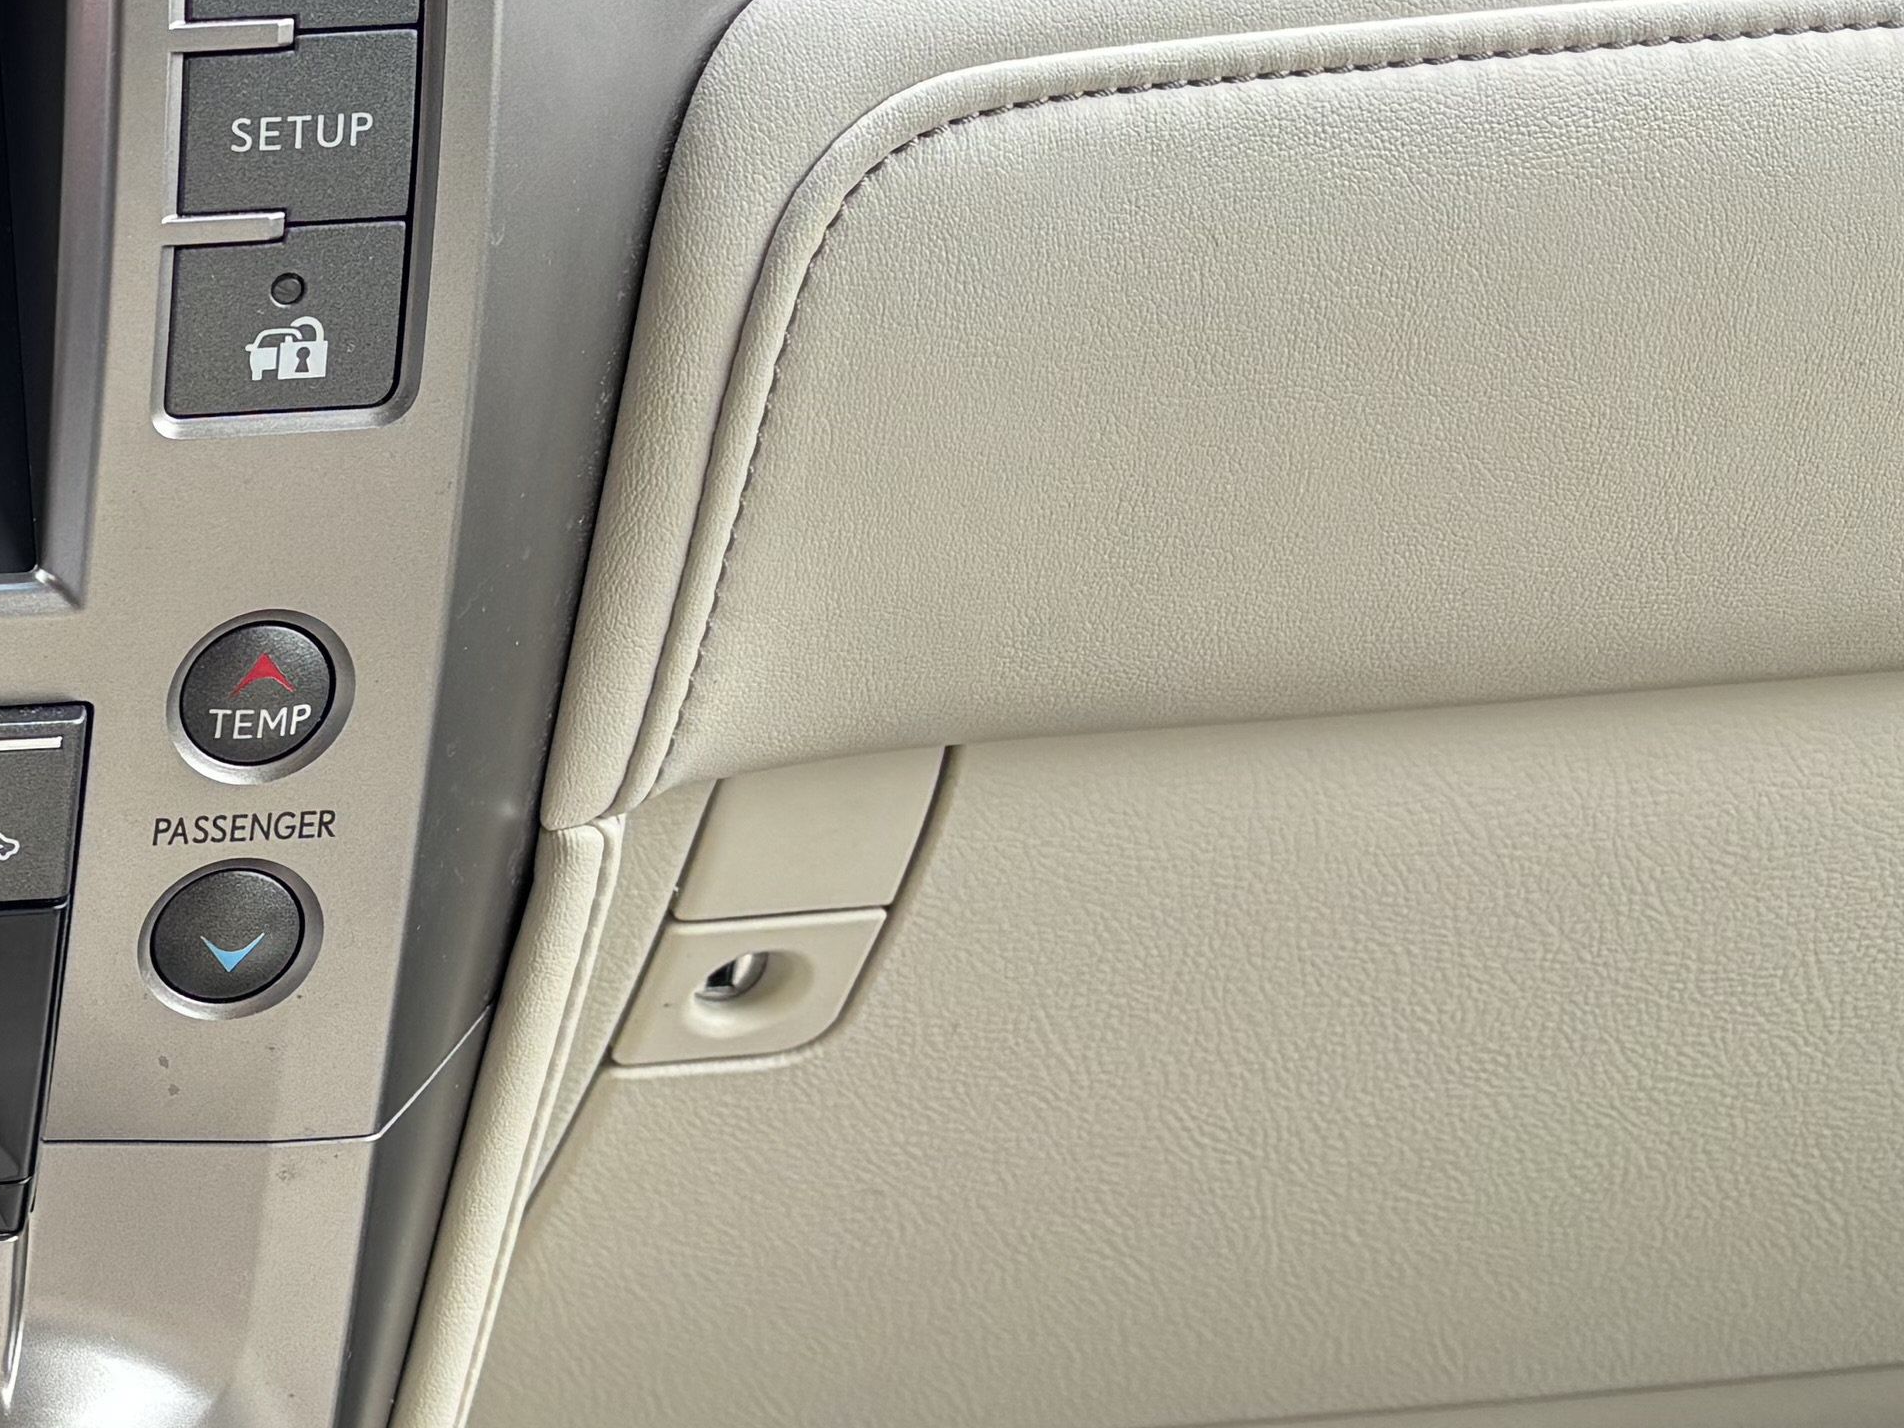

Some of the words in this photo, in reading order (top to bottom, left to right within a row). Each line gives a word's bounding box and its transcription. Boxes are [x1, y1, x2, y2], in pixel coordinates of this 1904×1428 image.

[230, 112, 375, 153] SETUP
[208, 703, 313, 740] TEMP
[151, 809, 337, 847] PASSENGER
